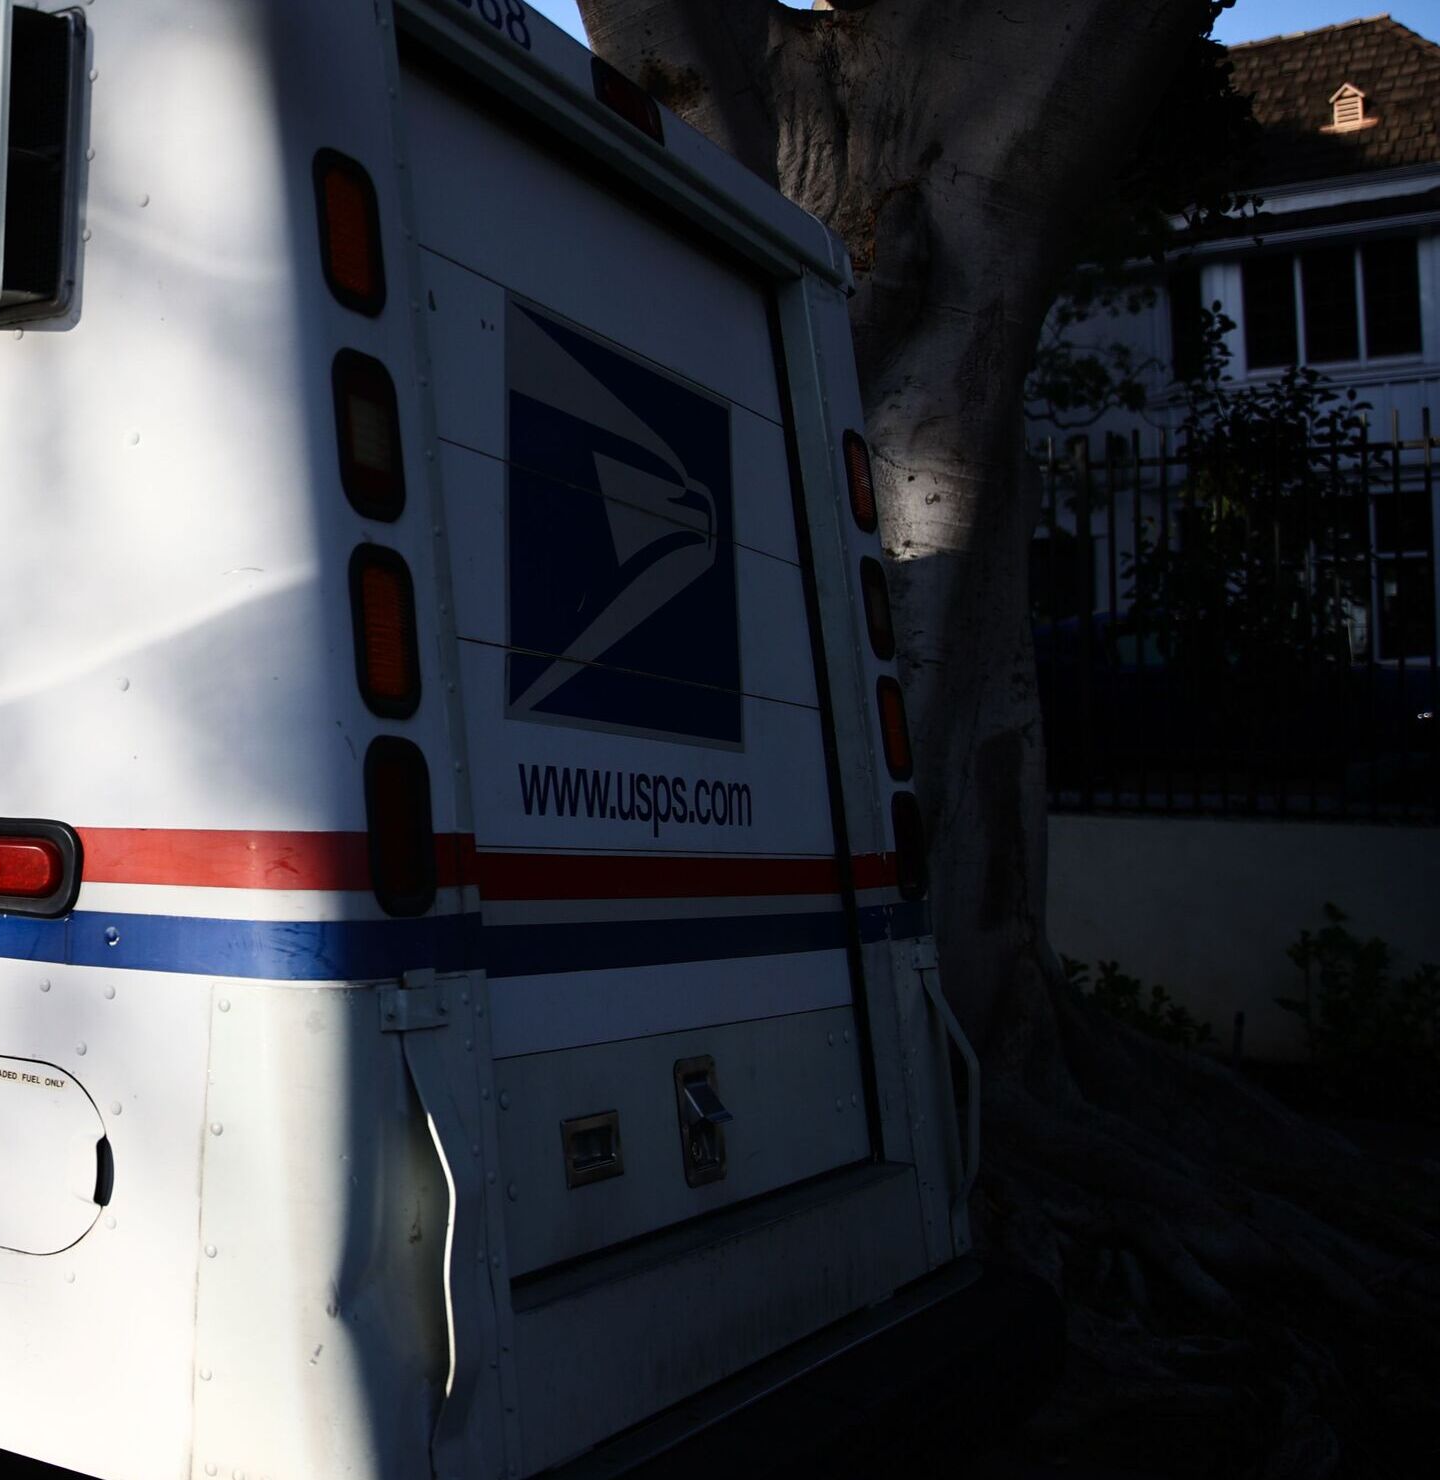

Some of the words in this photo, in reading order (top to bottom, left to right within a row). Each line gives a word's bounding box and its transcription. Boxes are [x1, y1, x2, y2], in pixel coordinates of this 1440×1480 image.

[518, 763, 752, 838] www.usps.com
[22, 1073, 40, 1084] FUEL
[45, 1078, 65, 1088] ONLY
